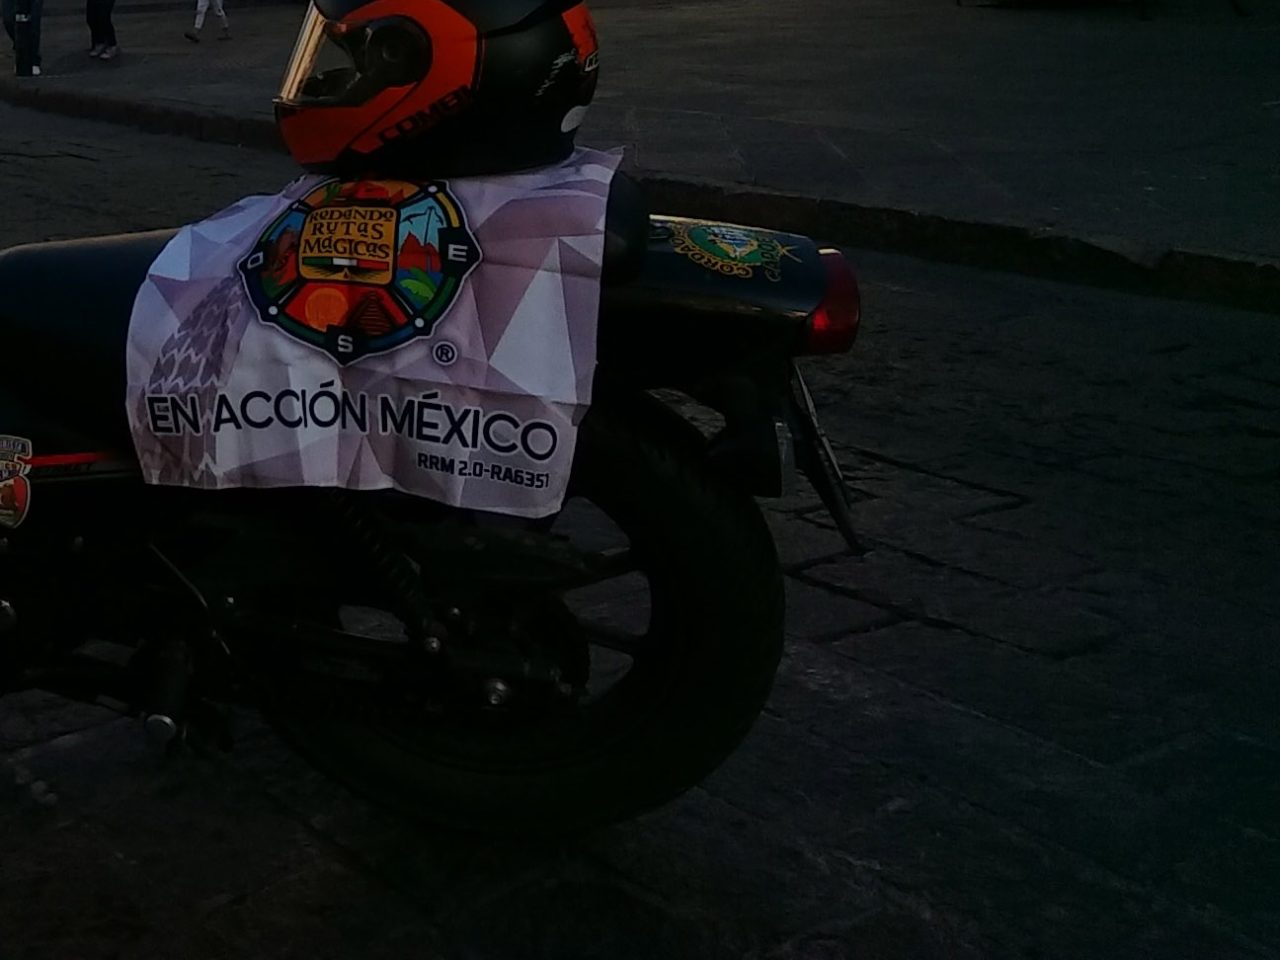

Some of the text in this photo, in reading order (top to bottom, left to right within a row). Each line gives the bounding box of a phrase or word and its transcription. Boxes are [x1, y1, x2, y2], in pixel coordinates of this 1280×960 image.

[145, 381, 559, 462] EN ACCIÓN MÉXICO
[417, 452, 455, 476] RRM
